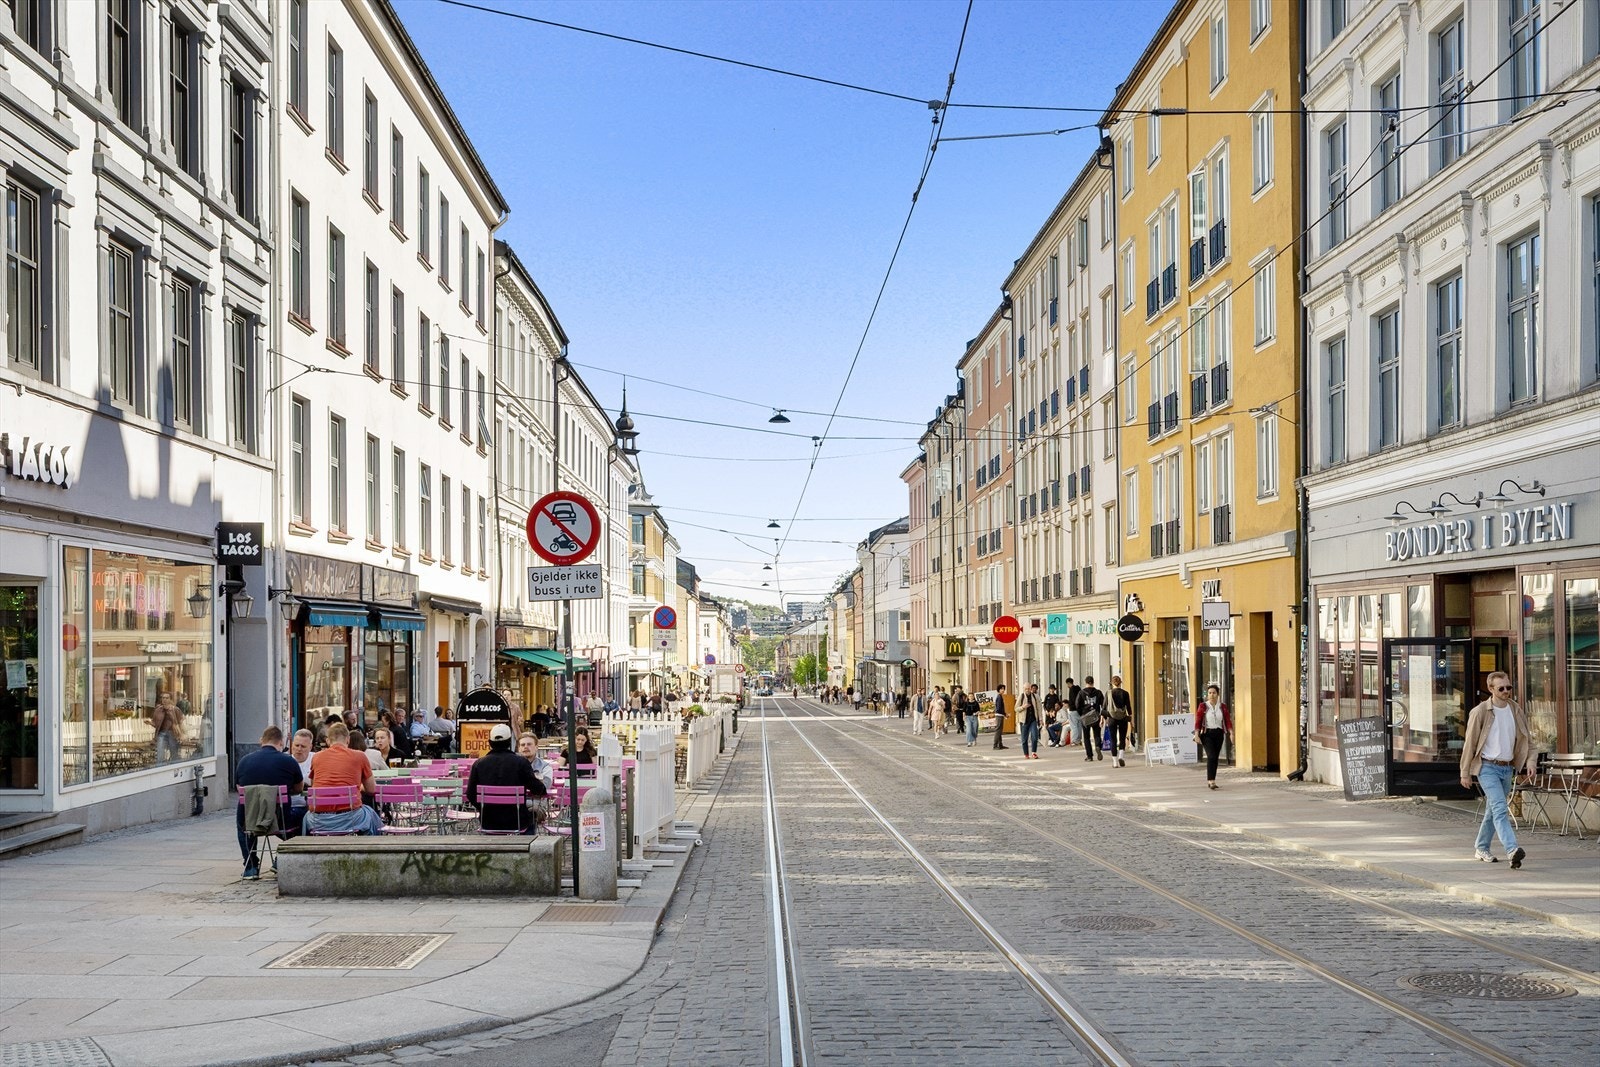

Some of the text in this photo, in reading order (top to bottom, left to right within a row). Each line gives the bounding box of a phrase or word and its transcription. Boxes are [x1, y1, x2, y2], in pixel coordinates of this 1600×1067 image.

[8, 433, 74, 489] TACOS
[229, 532, 251, 544] LOS
[1385, 502, 1573, 562] BØNDER I BYEN
[221, 544, 259, 556] TACOS
[531, 570, 599, 584] Gjelder ikke
[534, 584, 597, 596] buss i rute
[465, 704, 502, 712] LOS TACOS
